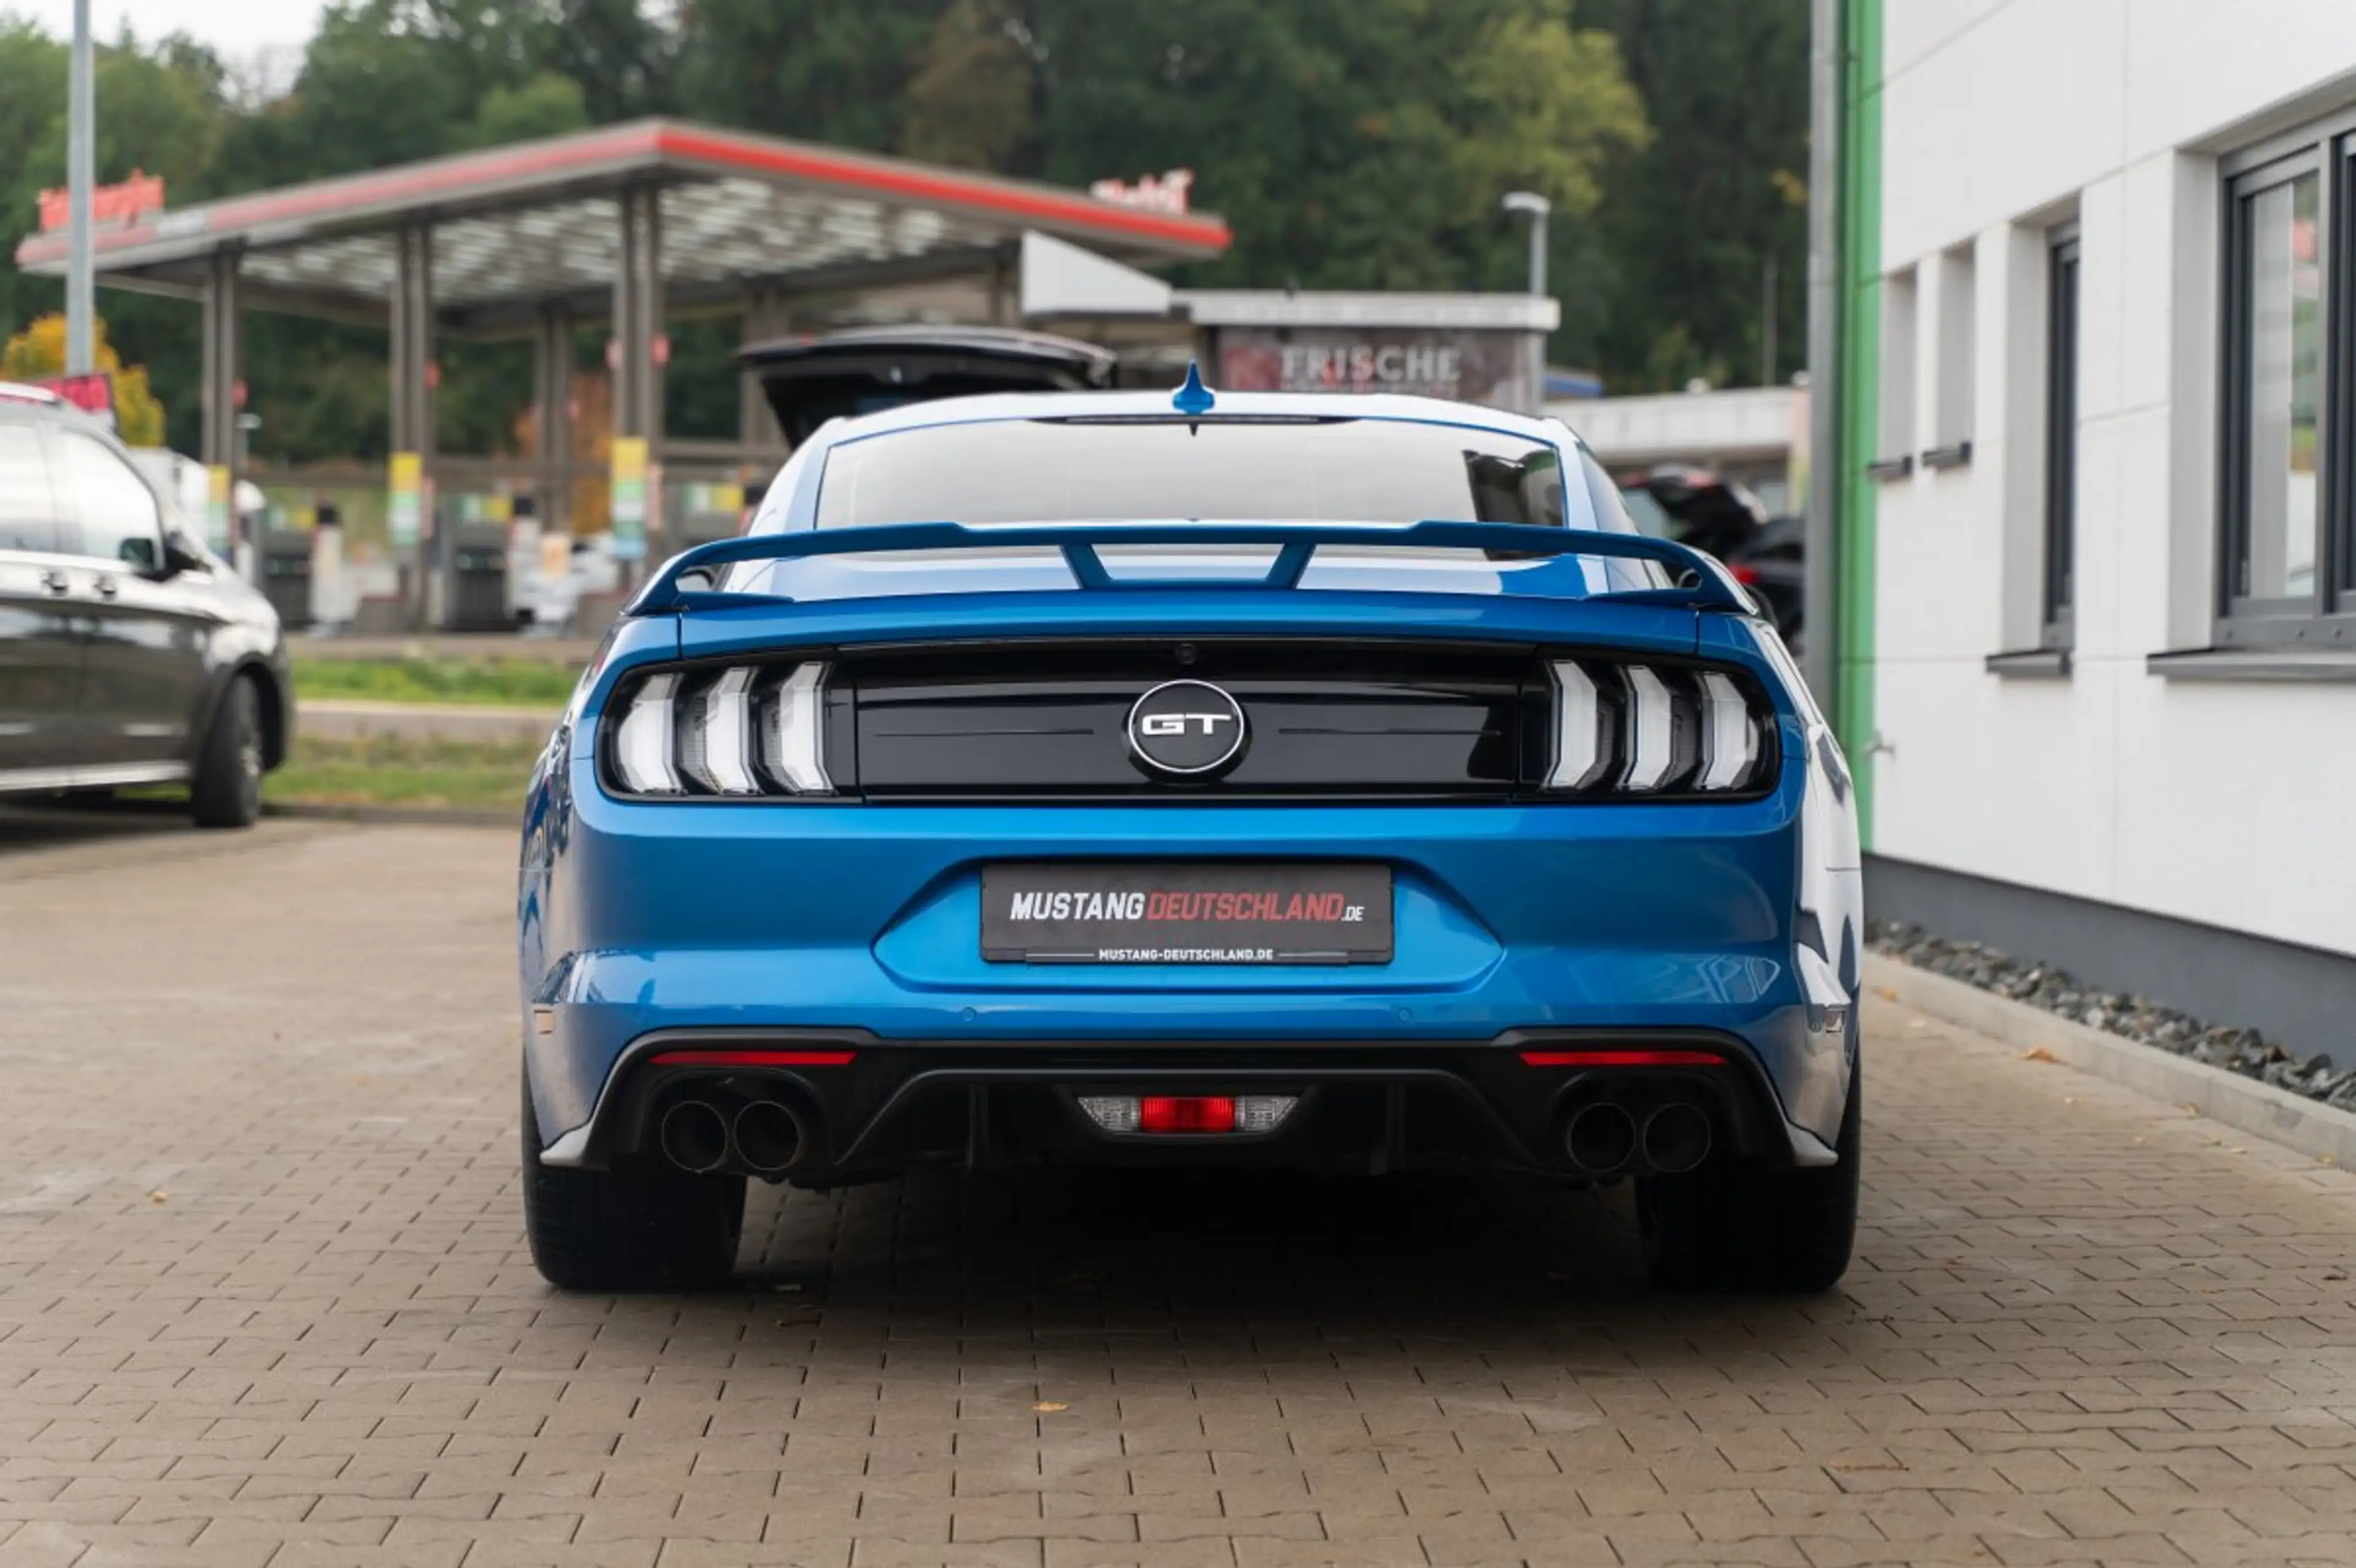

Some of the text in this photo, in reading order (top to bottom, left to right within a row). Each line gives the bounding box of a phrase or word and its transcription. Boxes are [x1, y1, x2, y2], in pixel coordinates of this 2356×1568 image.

[1282, 345, 1461, 381] FRISCHE
[1142, 713, 1231, 735] GT
[1099, 949, 1273, 961] MUSTANG-DEUTSCHLAND.DE
